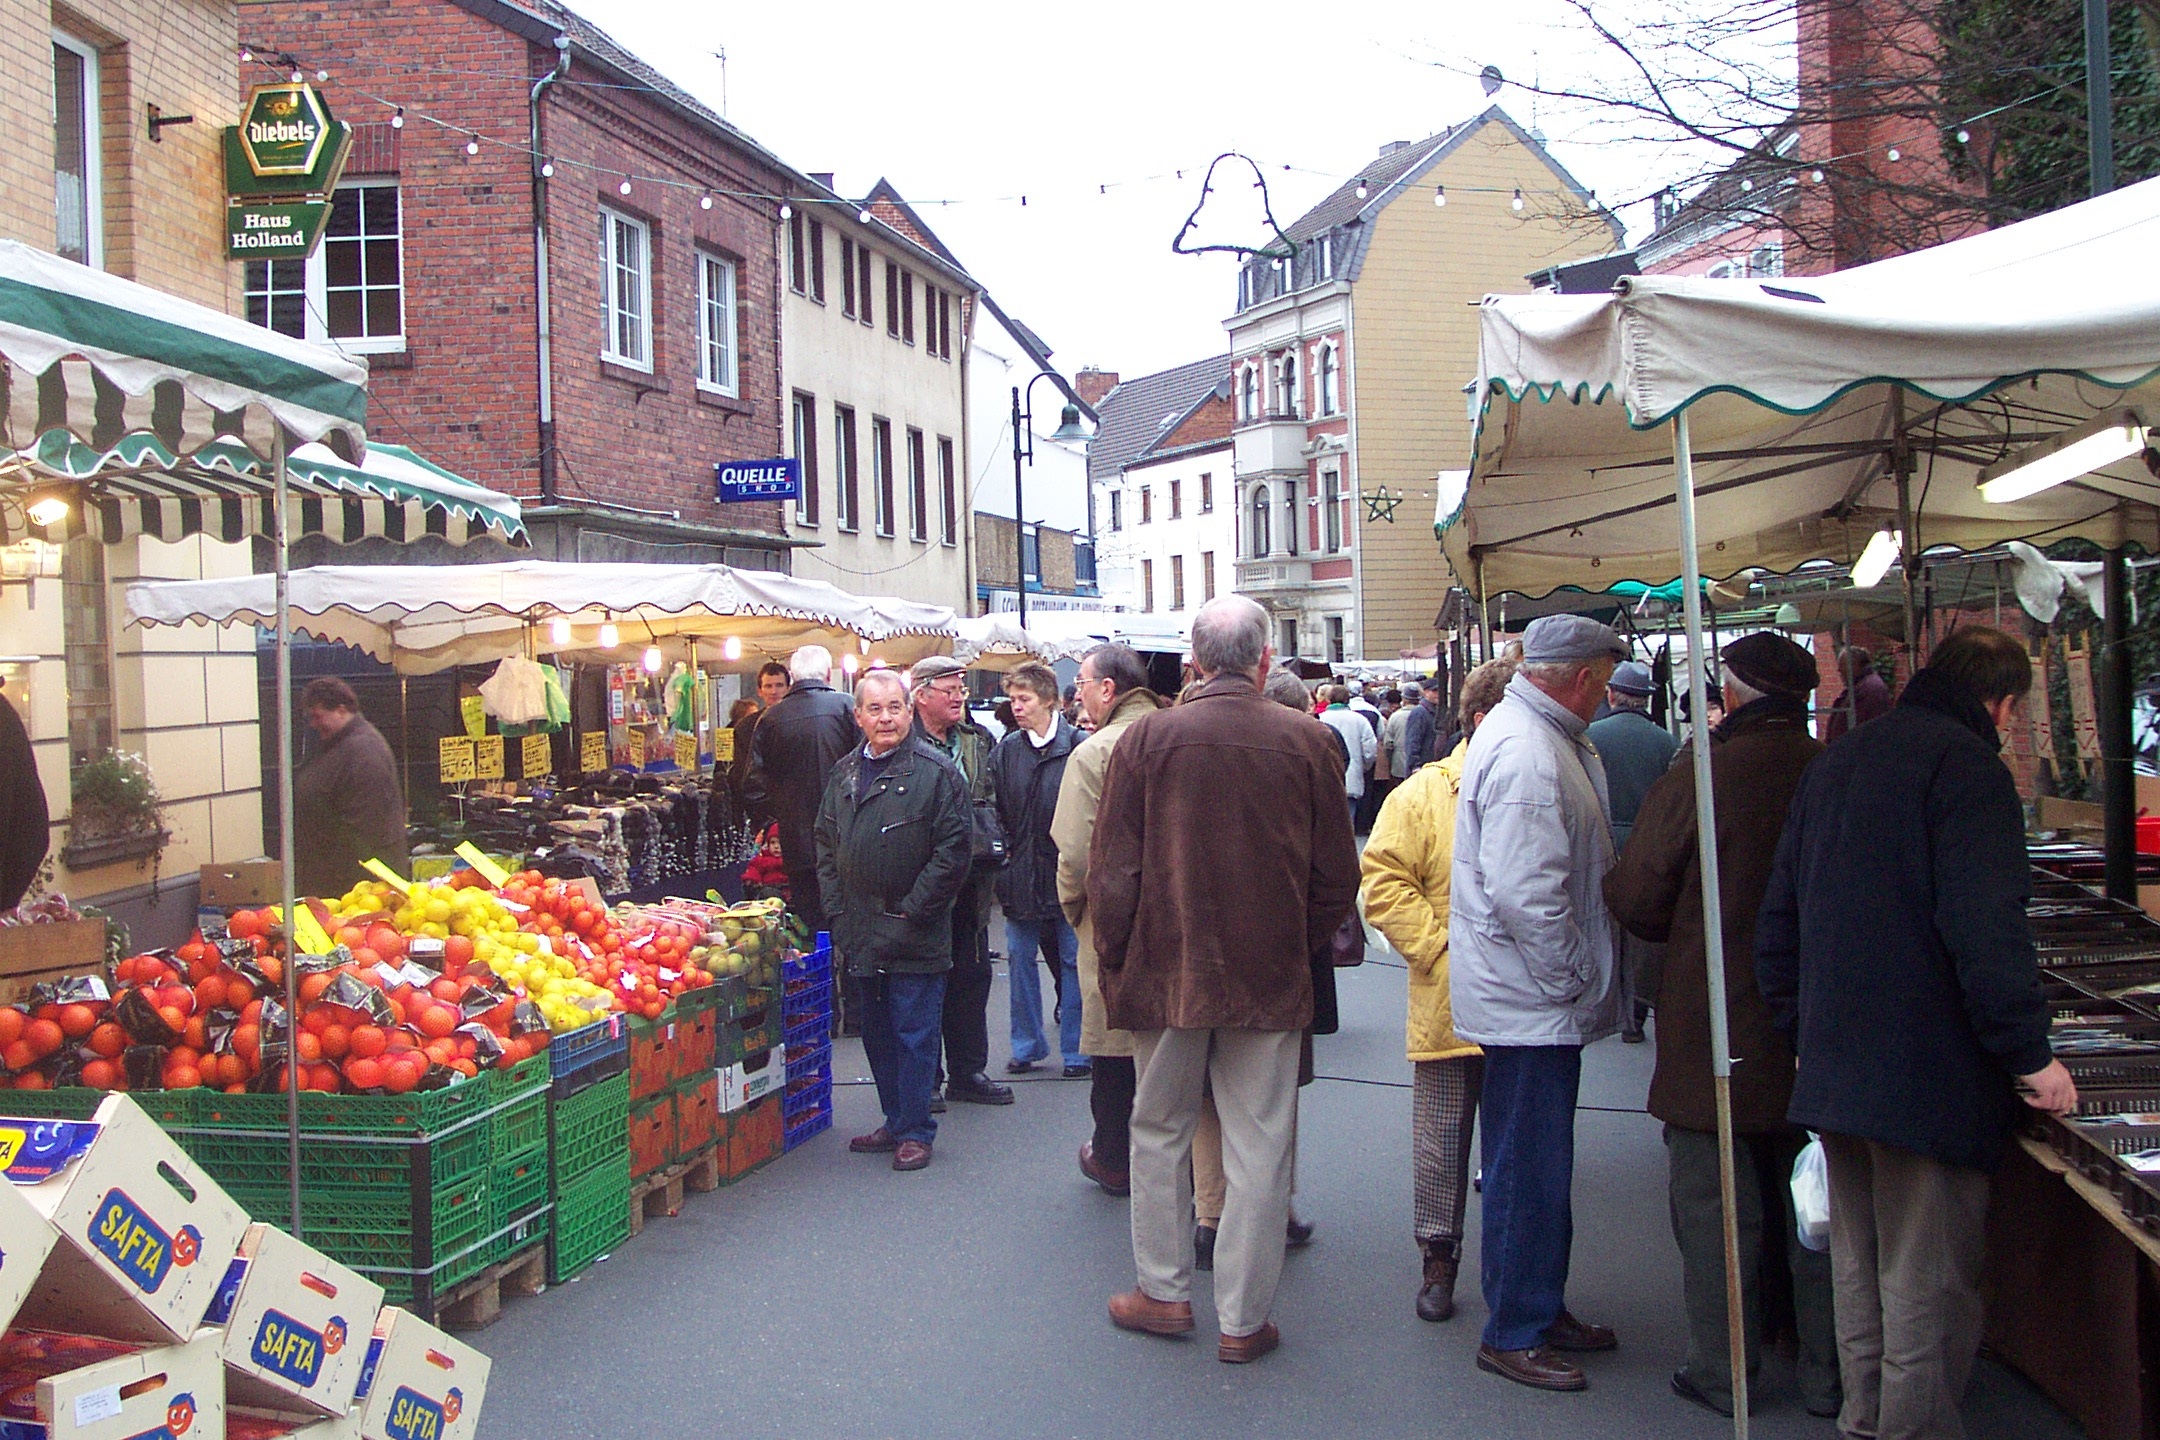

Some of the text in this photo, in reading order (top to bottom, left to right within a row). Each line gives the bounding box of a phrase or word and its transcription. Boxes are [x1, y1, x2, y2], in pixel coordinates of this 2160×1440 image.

[244, 213, 292, 229] Haus
[232, 230, 305, 249] Holland
[740, 483, 792, 493] SHOP
[100, 1204, 165, 1279] SAFTA
[260, 1322, 317, 1375] SAFTA
[393, 1398, 438, 1440] SAFTA
